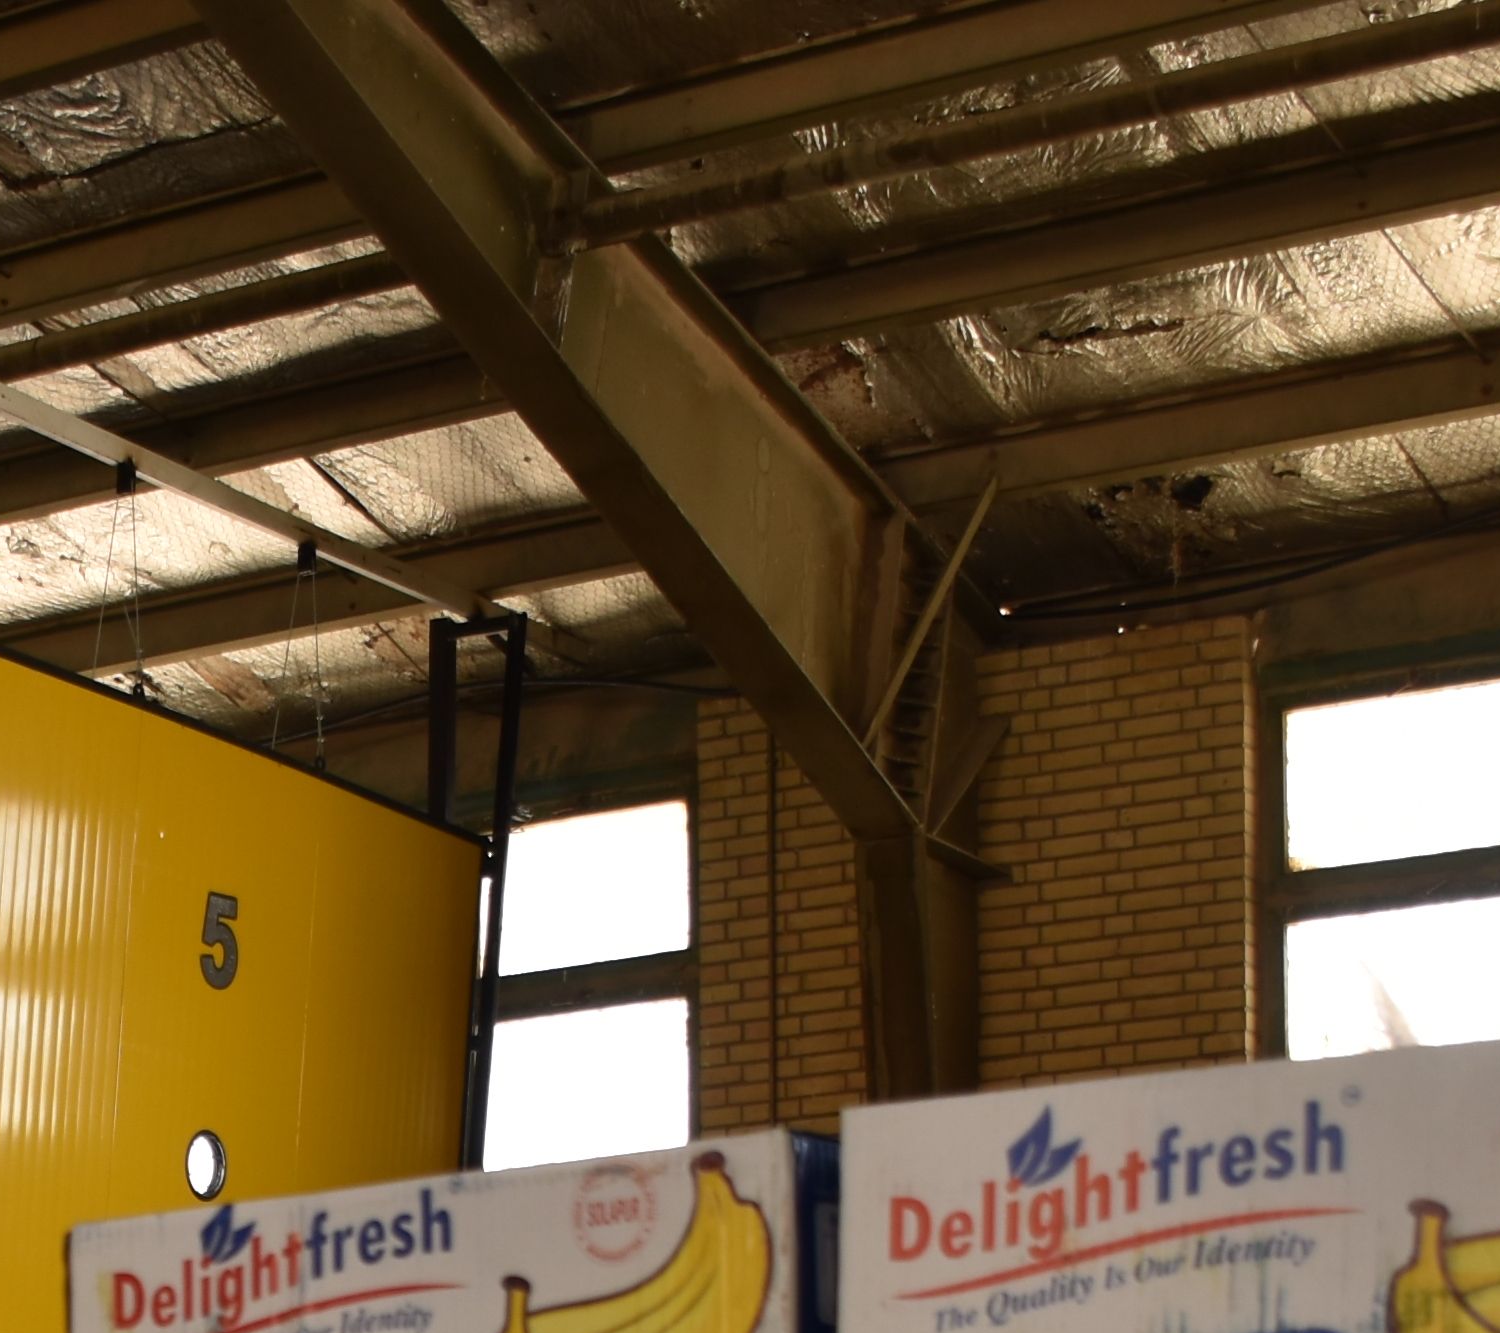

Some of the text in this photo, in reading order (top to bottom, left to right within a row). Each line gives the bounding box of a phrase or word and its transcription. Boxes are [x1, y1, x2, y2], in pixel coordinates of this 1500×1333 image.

[200, 891, 238, 990] 5
[889, 1101, 1343, 1260] Delightfresh
[113, 1188, 451, 1328] Delightfresh
[936, 1303, 979, 1332] The
[987, 1274, 1094, 1324] Quality
[1193, 1230, 1318, 1269] Identity
